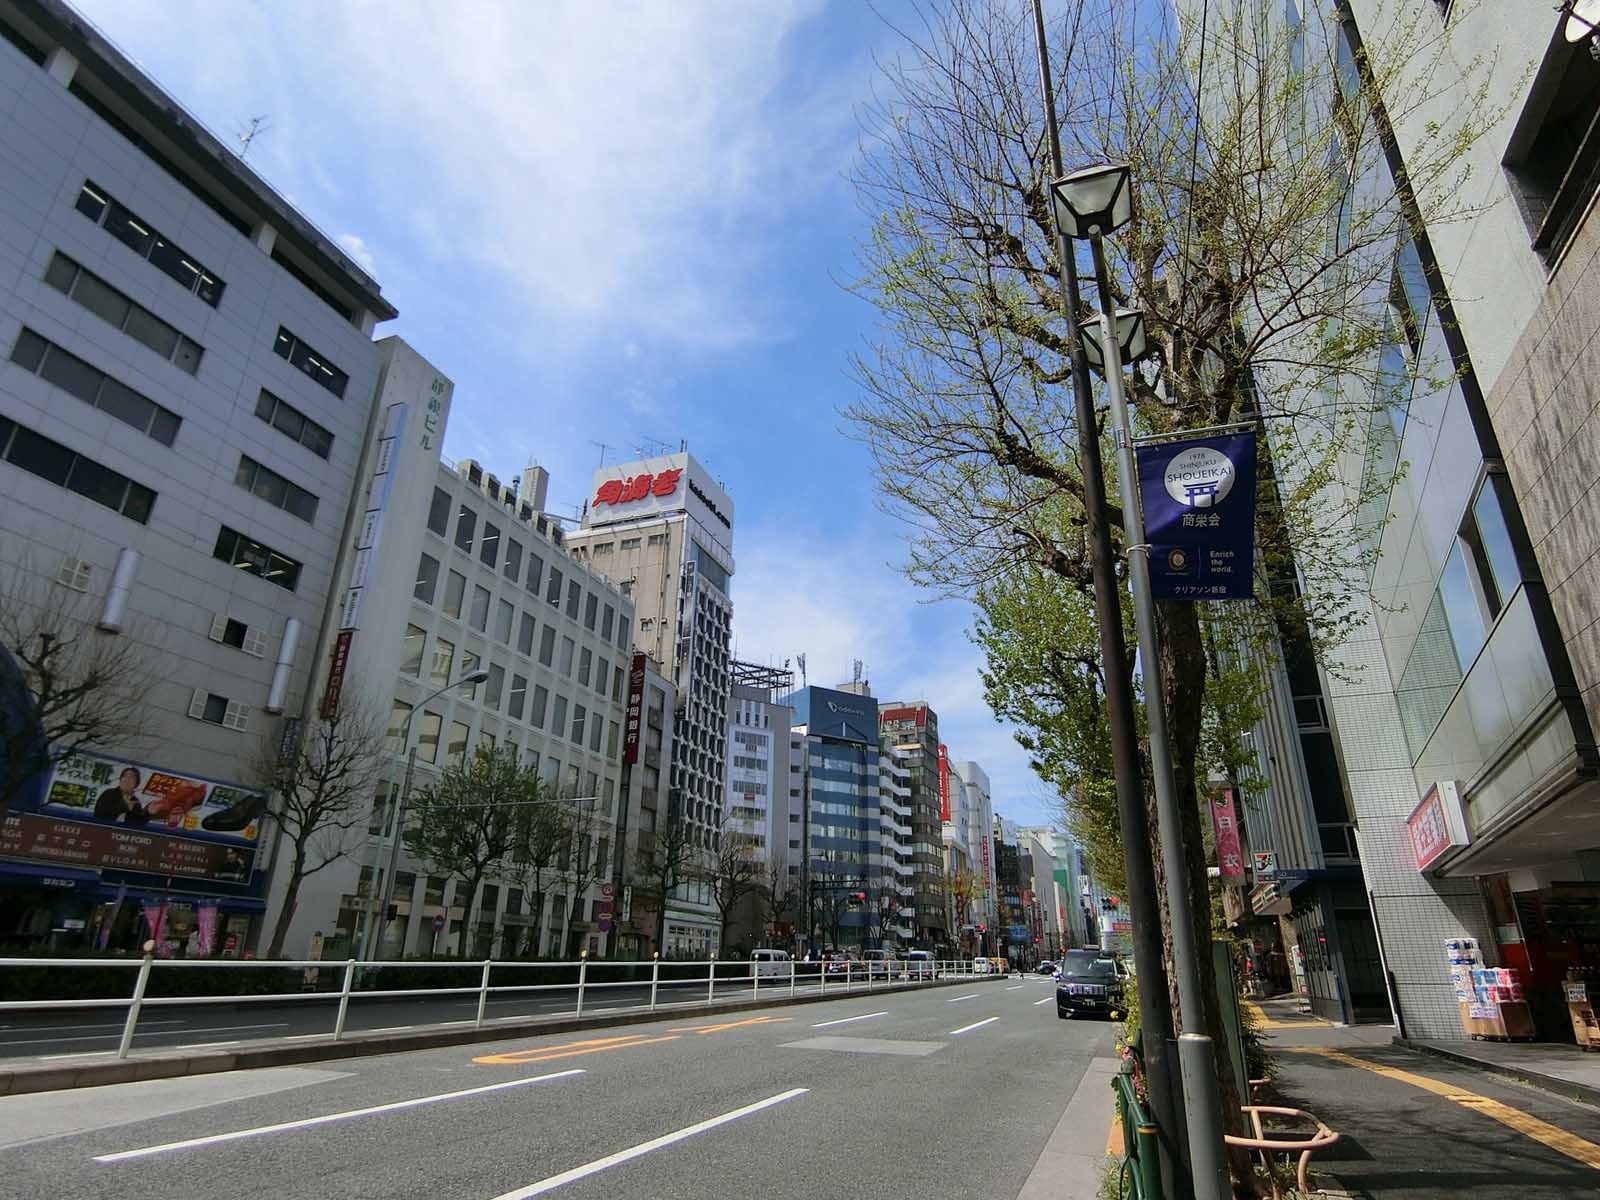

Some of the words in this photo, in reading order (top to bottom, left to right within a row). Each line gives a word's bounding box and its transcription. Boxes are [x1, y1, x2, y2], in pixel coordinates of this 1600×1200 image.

[1189, 453, 1206, 461] 1978
[1180, 459, 1217, 470] SHINJUKU
[1167, 466, 1232, 483] SHOUEIKAI
[592, 468, 684, 507] 角海老
[1182, 513, 1221, 528] 商栄会
[1209, 550, 1235, 558] Enrich
[1211, 559, 1223, 567] the
[1174, 585, 1227, 595] クリアソン新宿
[627, 693, 641, 744] 静岡銀行
[112, 832, 131, 842] TOM
[130, 835, 153, 845] FORD
